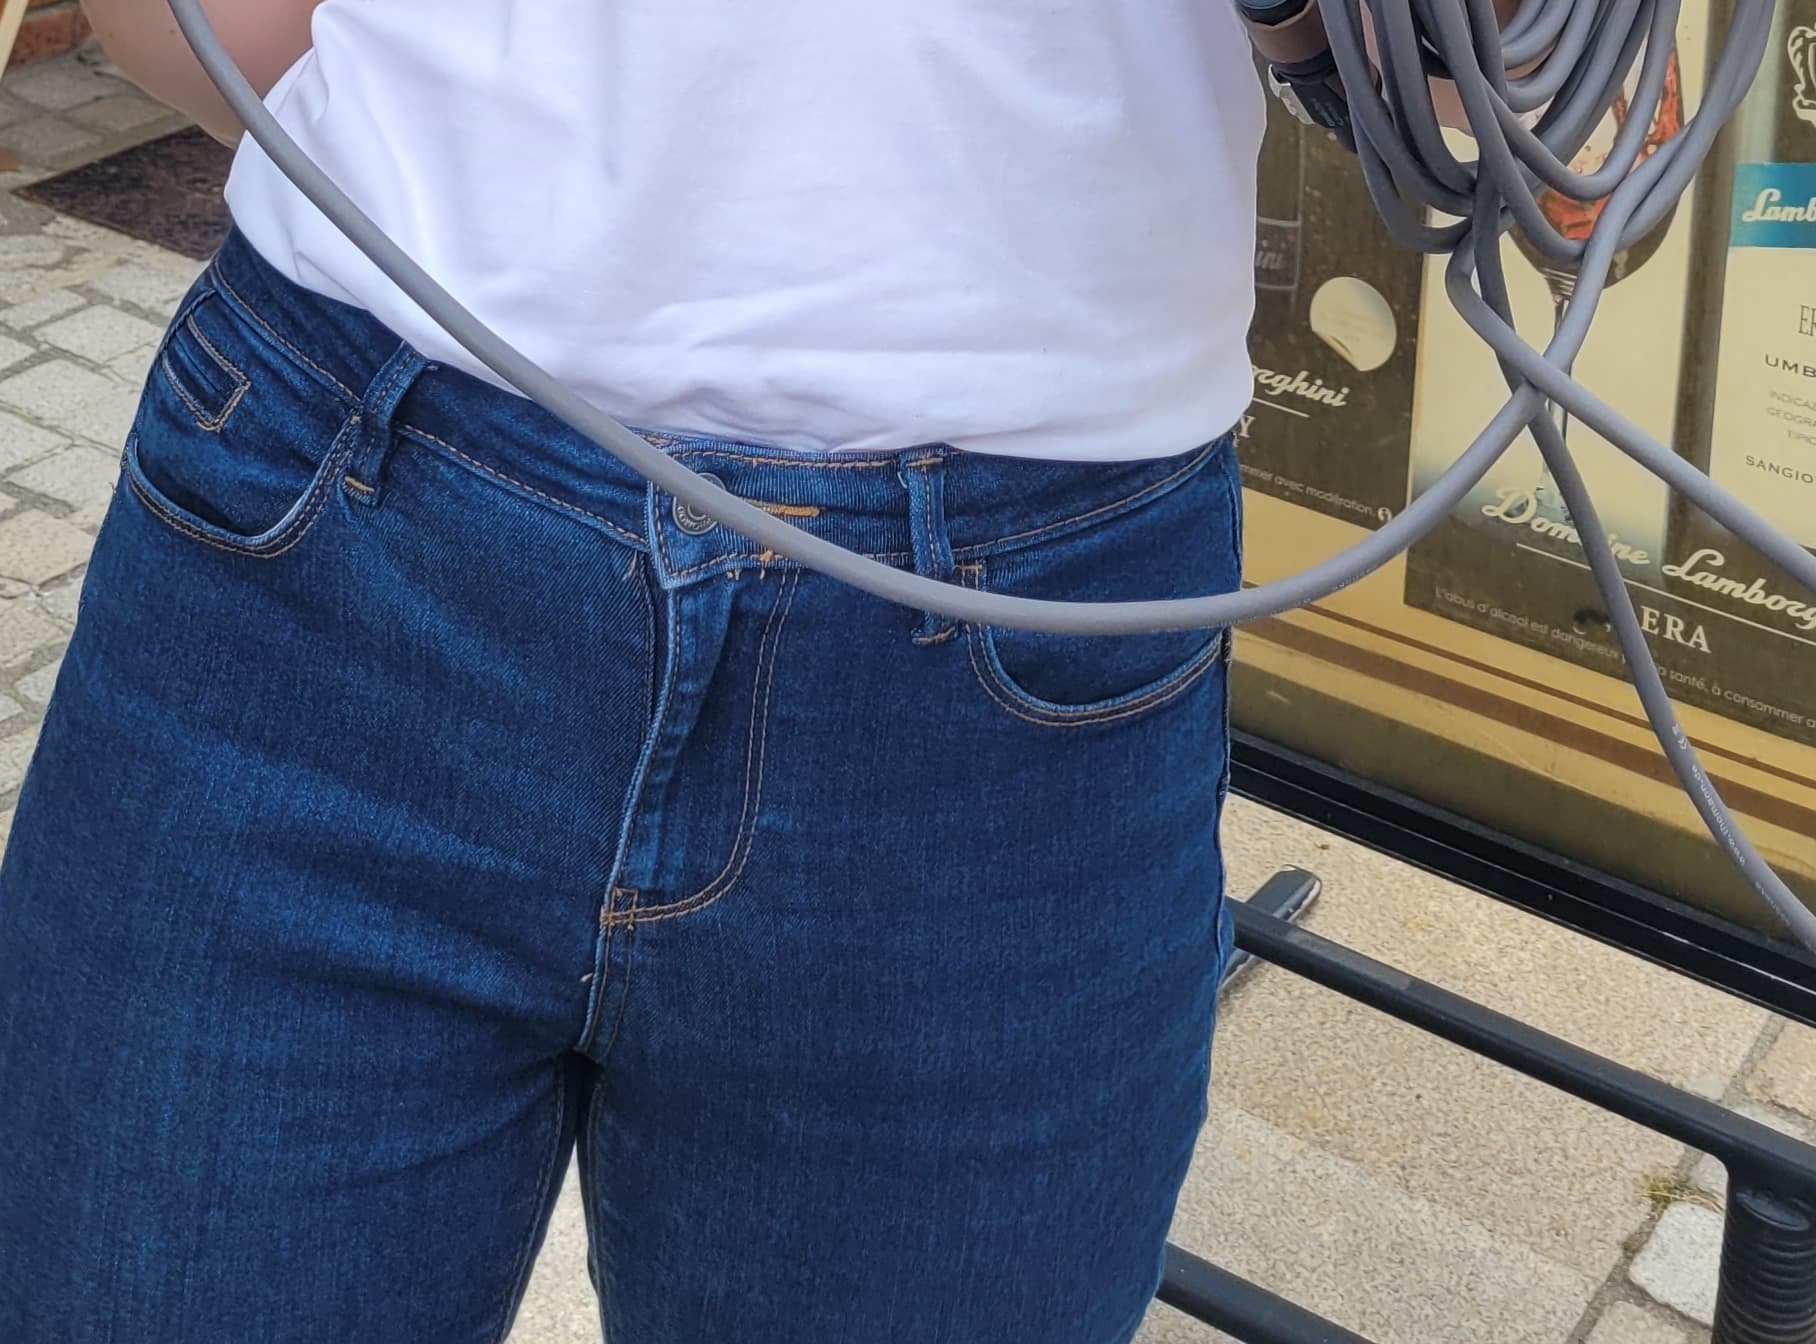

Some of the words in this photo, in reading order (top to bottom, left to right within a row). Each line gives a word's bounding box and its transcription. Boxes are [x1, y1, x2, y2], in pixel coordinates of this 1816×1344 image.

[1481, 486, 1651, 565] Domine
[1531, 620, 1550, 635] est
[1724, 690, 1804, 723] consommer
